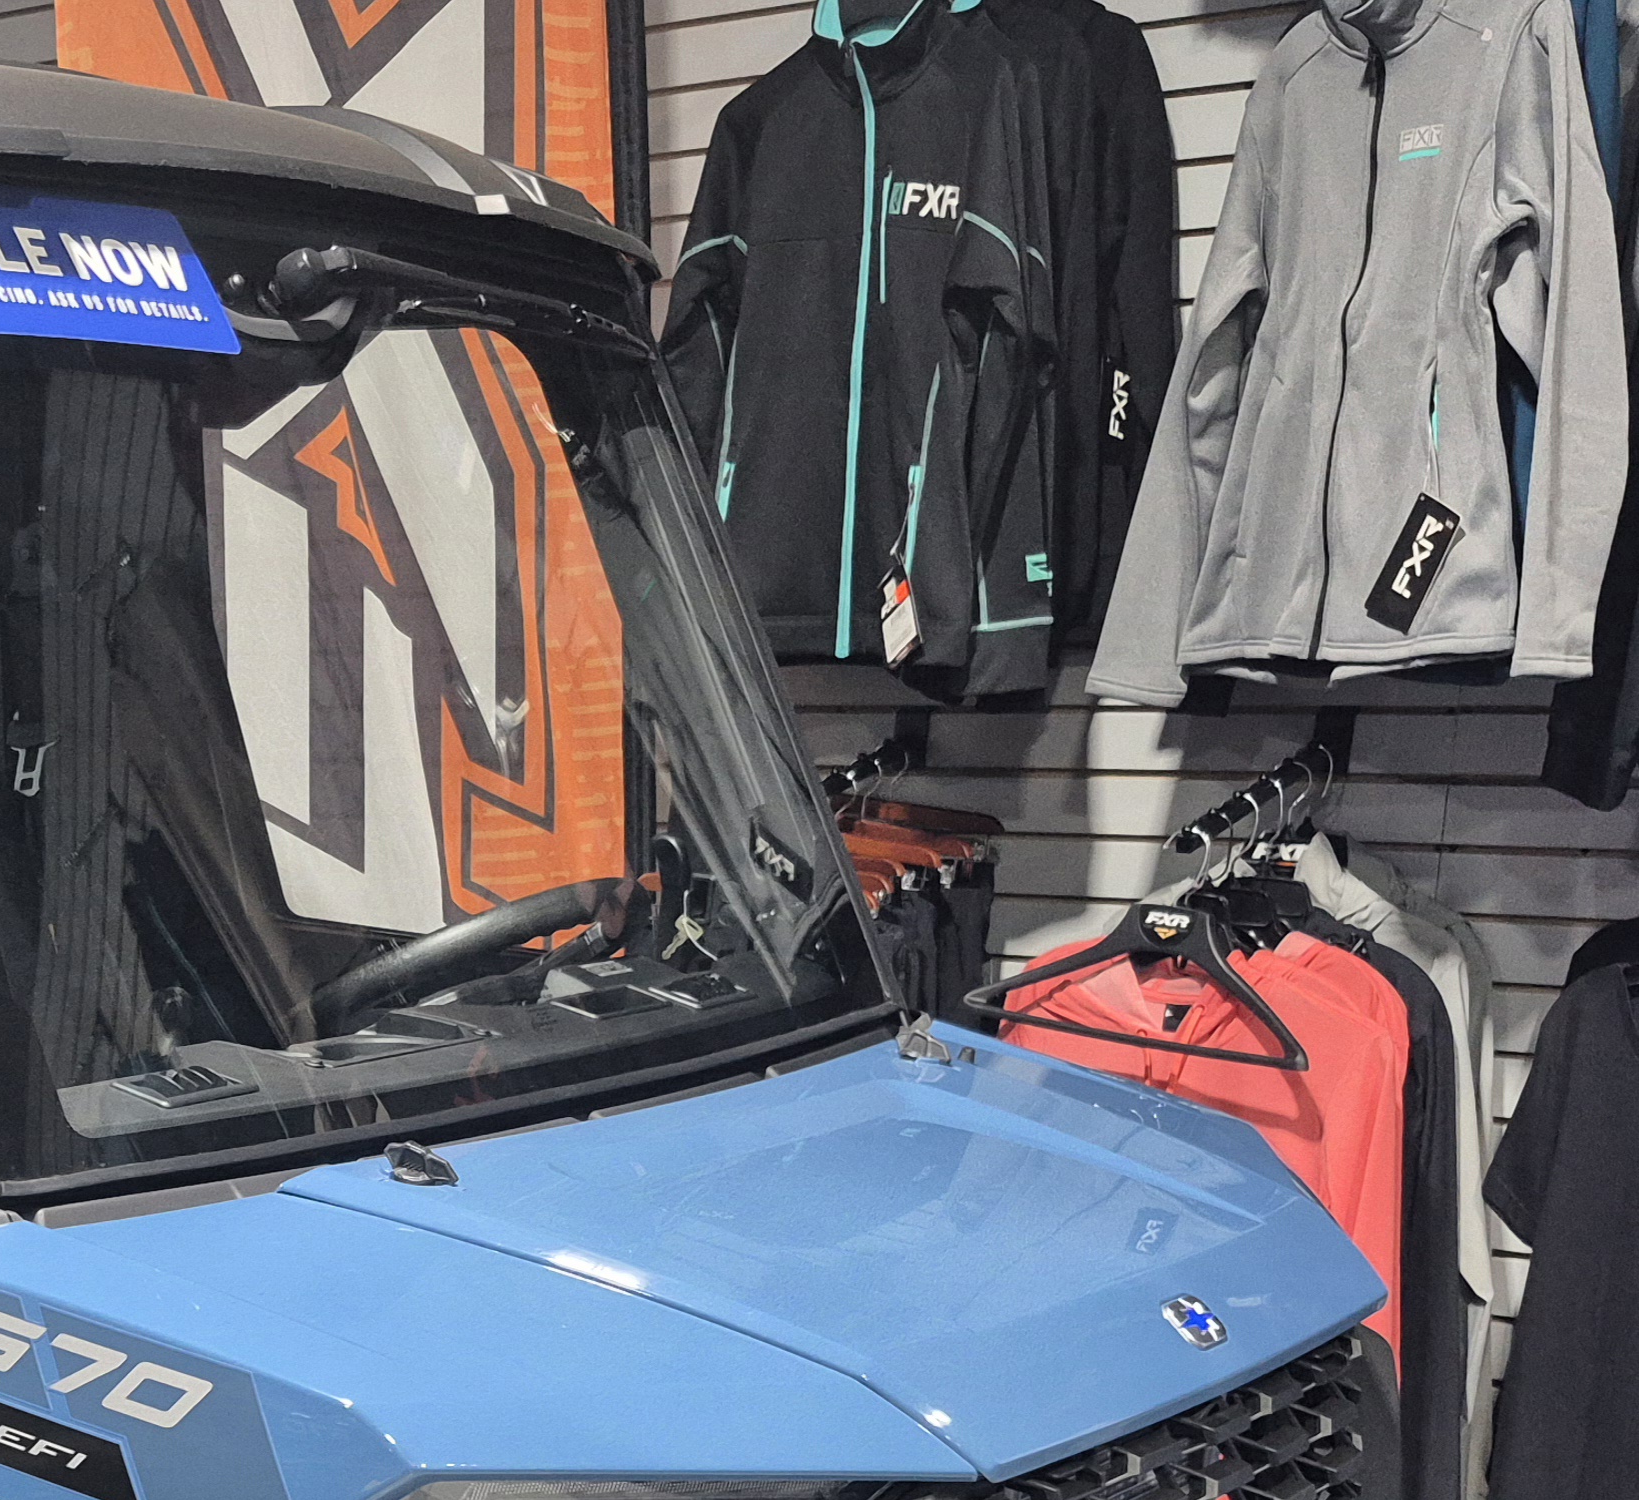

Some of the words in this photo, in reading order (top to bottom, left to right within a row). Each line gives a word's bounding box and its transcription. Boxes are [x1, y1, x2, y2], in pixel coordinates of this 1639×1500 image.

[1400, 124, 1444, 152] FXR
[901, 182, 961, 220] FXR
[61, 232, 189, 292] NOW
[48, 290, 80, 309] ASK
[85, 294, 104, 311] US
[108, 296, 138, 314] FOR
[140, 300, 210, 322] DETAILS.
[1108, 369, 1131, 441] FXR
[1391, 514, 1444, 600] FXR
[1144, 911, 1191, 929] FXR
